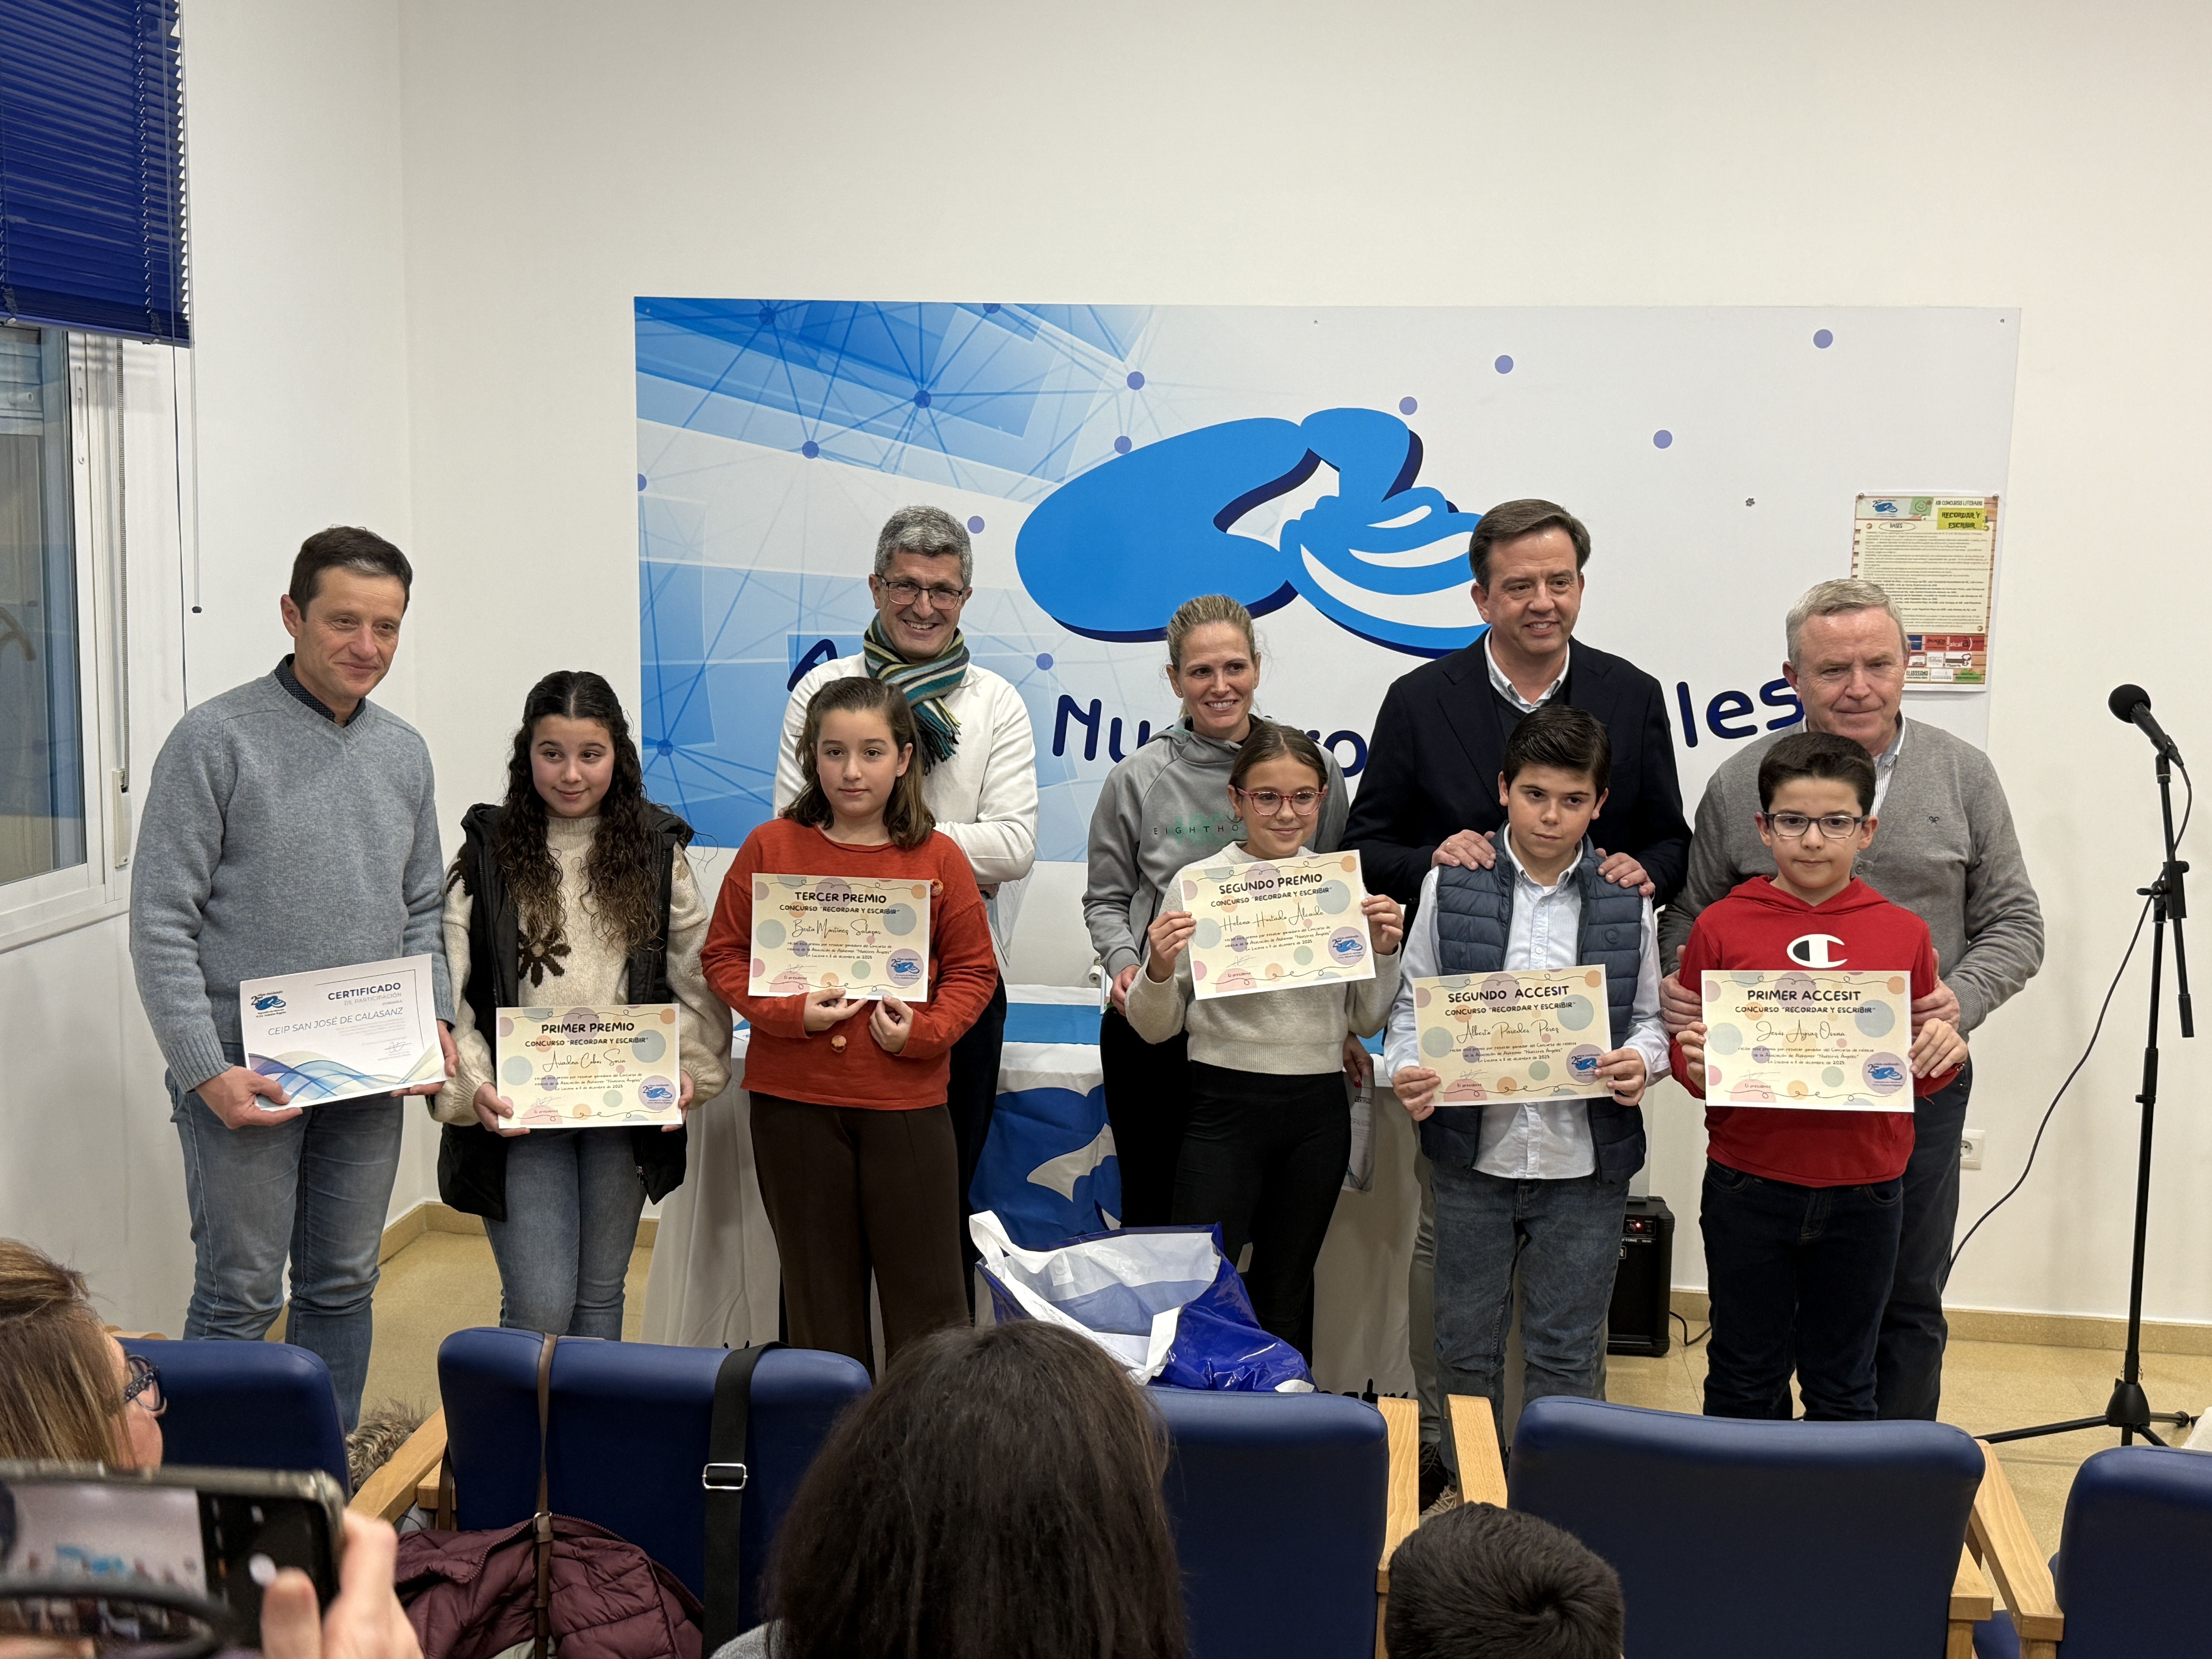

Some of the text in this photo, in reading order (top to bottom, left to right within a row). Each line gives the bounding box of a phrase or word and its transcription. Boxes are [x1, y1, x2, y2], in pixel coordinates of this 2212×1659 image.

[1219, 874, 1322, 895] SEGUNDO PREMIO
[795, 892, 886, 903] TERCER PREMIO
[1211, 897, 1249, 907] CONCURSO
[328, 982, 401, 1000] CERTIFICADO
[1448, 986, 1569, 1003] SEGUNDO ACCESIT
[1748, 990, 1861, 1001] PRIMER ACCESIT
[268, 1026, 290, 1035] CEIP
[292, 1022, 311, 1032] SAN
[314, 1016, 337, 1028] JOSÉ
[340, 1015, 352, 1024] DE
[355, 1007, 403, 1022] CALASANZ
[542, 1022, 634, 1034] PRIMER PREMIO
